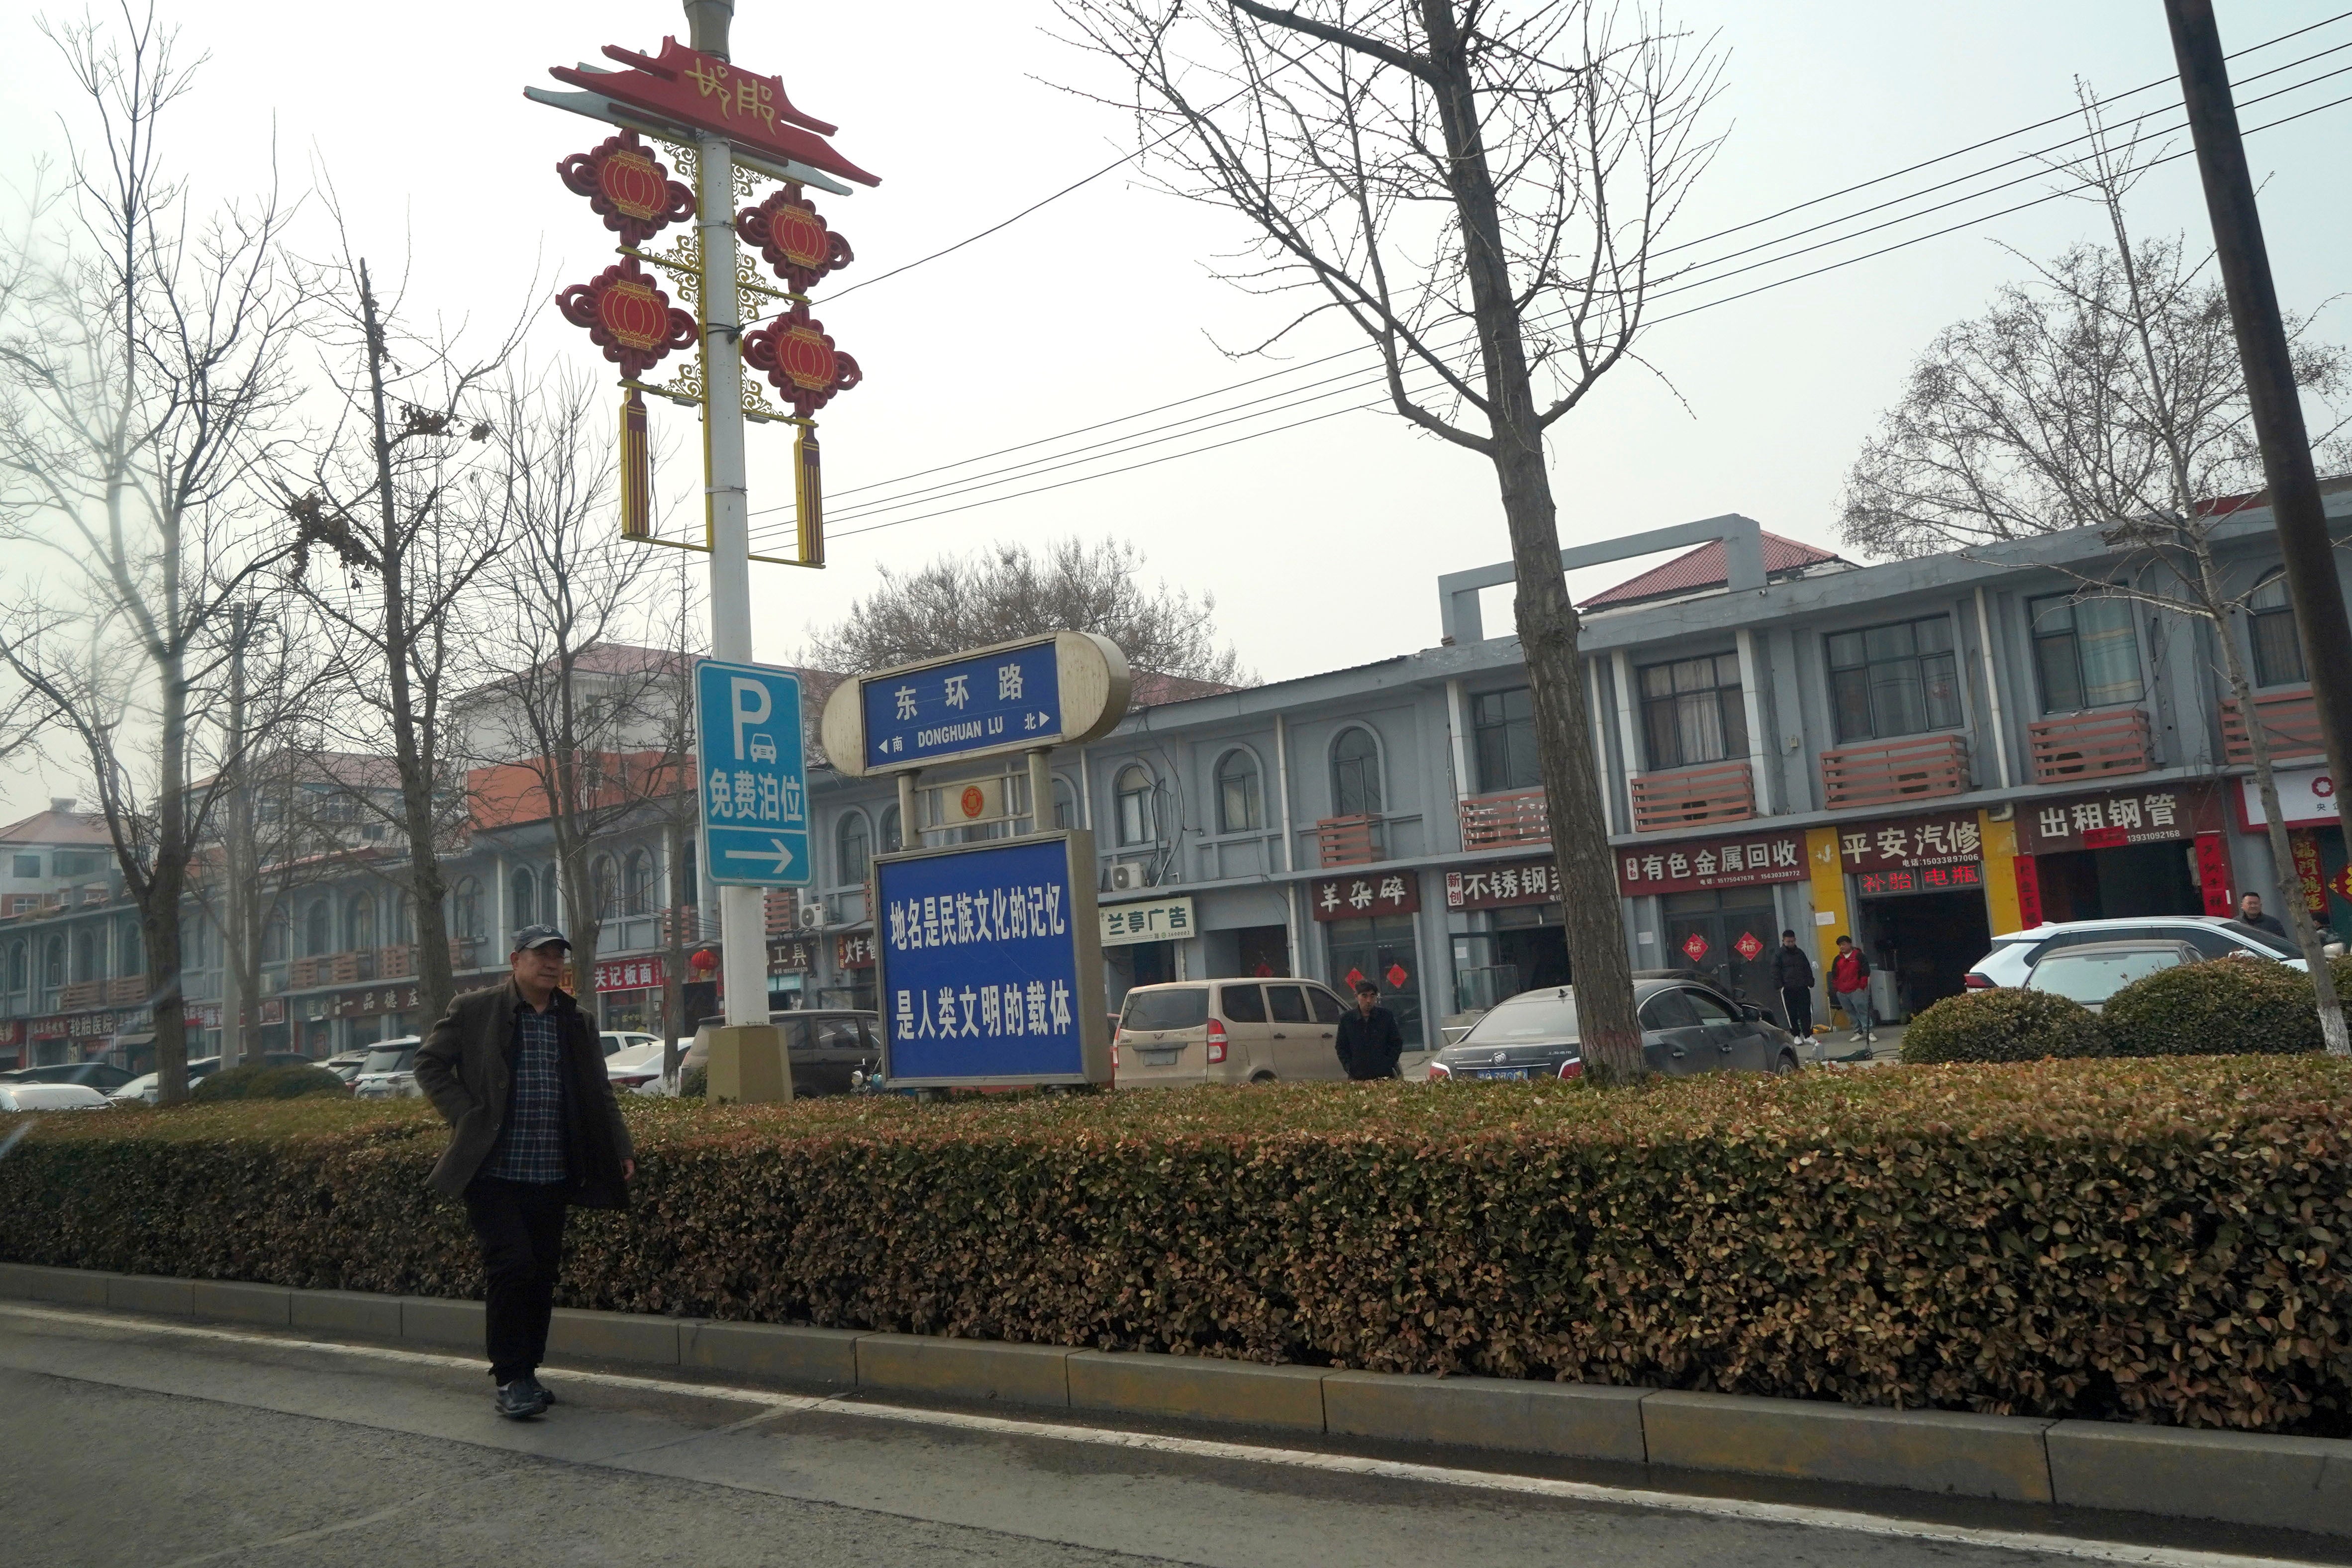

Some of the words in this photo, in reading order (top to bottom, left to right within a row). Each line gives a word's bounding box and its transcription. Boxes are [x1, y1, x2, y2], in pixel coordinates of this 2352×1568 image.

[894, 663, 1024, 721] 东环路
[731, 677, 772, 761] P
[918, 718, 982, 748] DONGHUAN
[988, 715, 1004, 735] LU
[1024, 713, 1037, 730] 北
[892, 735, 903, 752] 南
[709, 768, 803, 822] 免费泊位
[2039, 793, 2177, 838] 出租钢管
[1842, 821, 1981, 864] 平安汽修
[2126, 830, 2181, 843] 13931092168
[1642, 840, 1798, 881] 有色金属回收
[1320, 876, 1407, 913] 羊杂碎
[1448, 873, 1462, 904] 新创
[1862, 872, 1912, 892] 补胎
[1924, 865, 1978, 885] 电瓶
[889, 882, 1065, 951] 地名是民族文化的记忆
[1108, 906, 1187, 936] 兰亭广告
[766, 943, 807, 966] 工具
[69, 1013, 114, 1037] 轮胎医院
[896, 980, 1072, 1040] 是人类文明的载体
